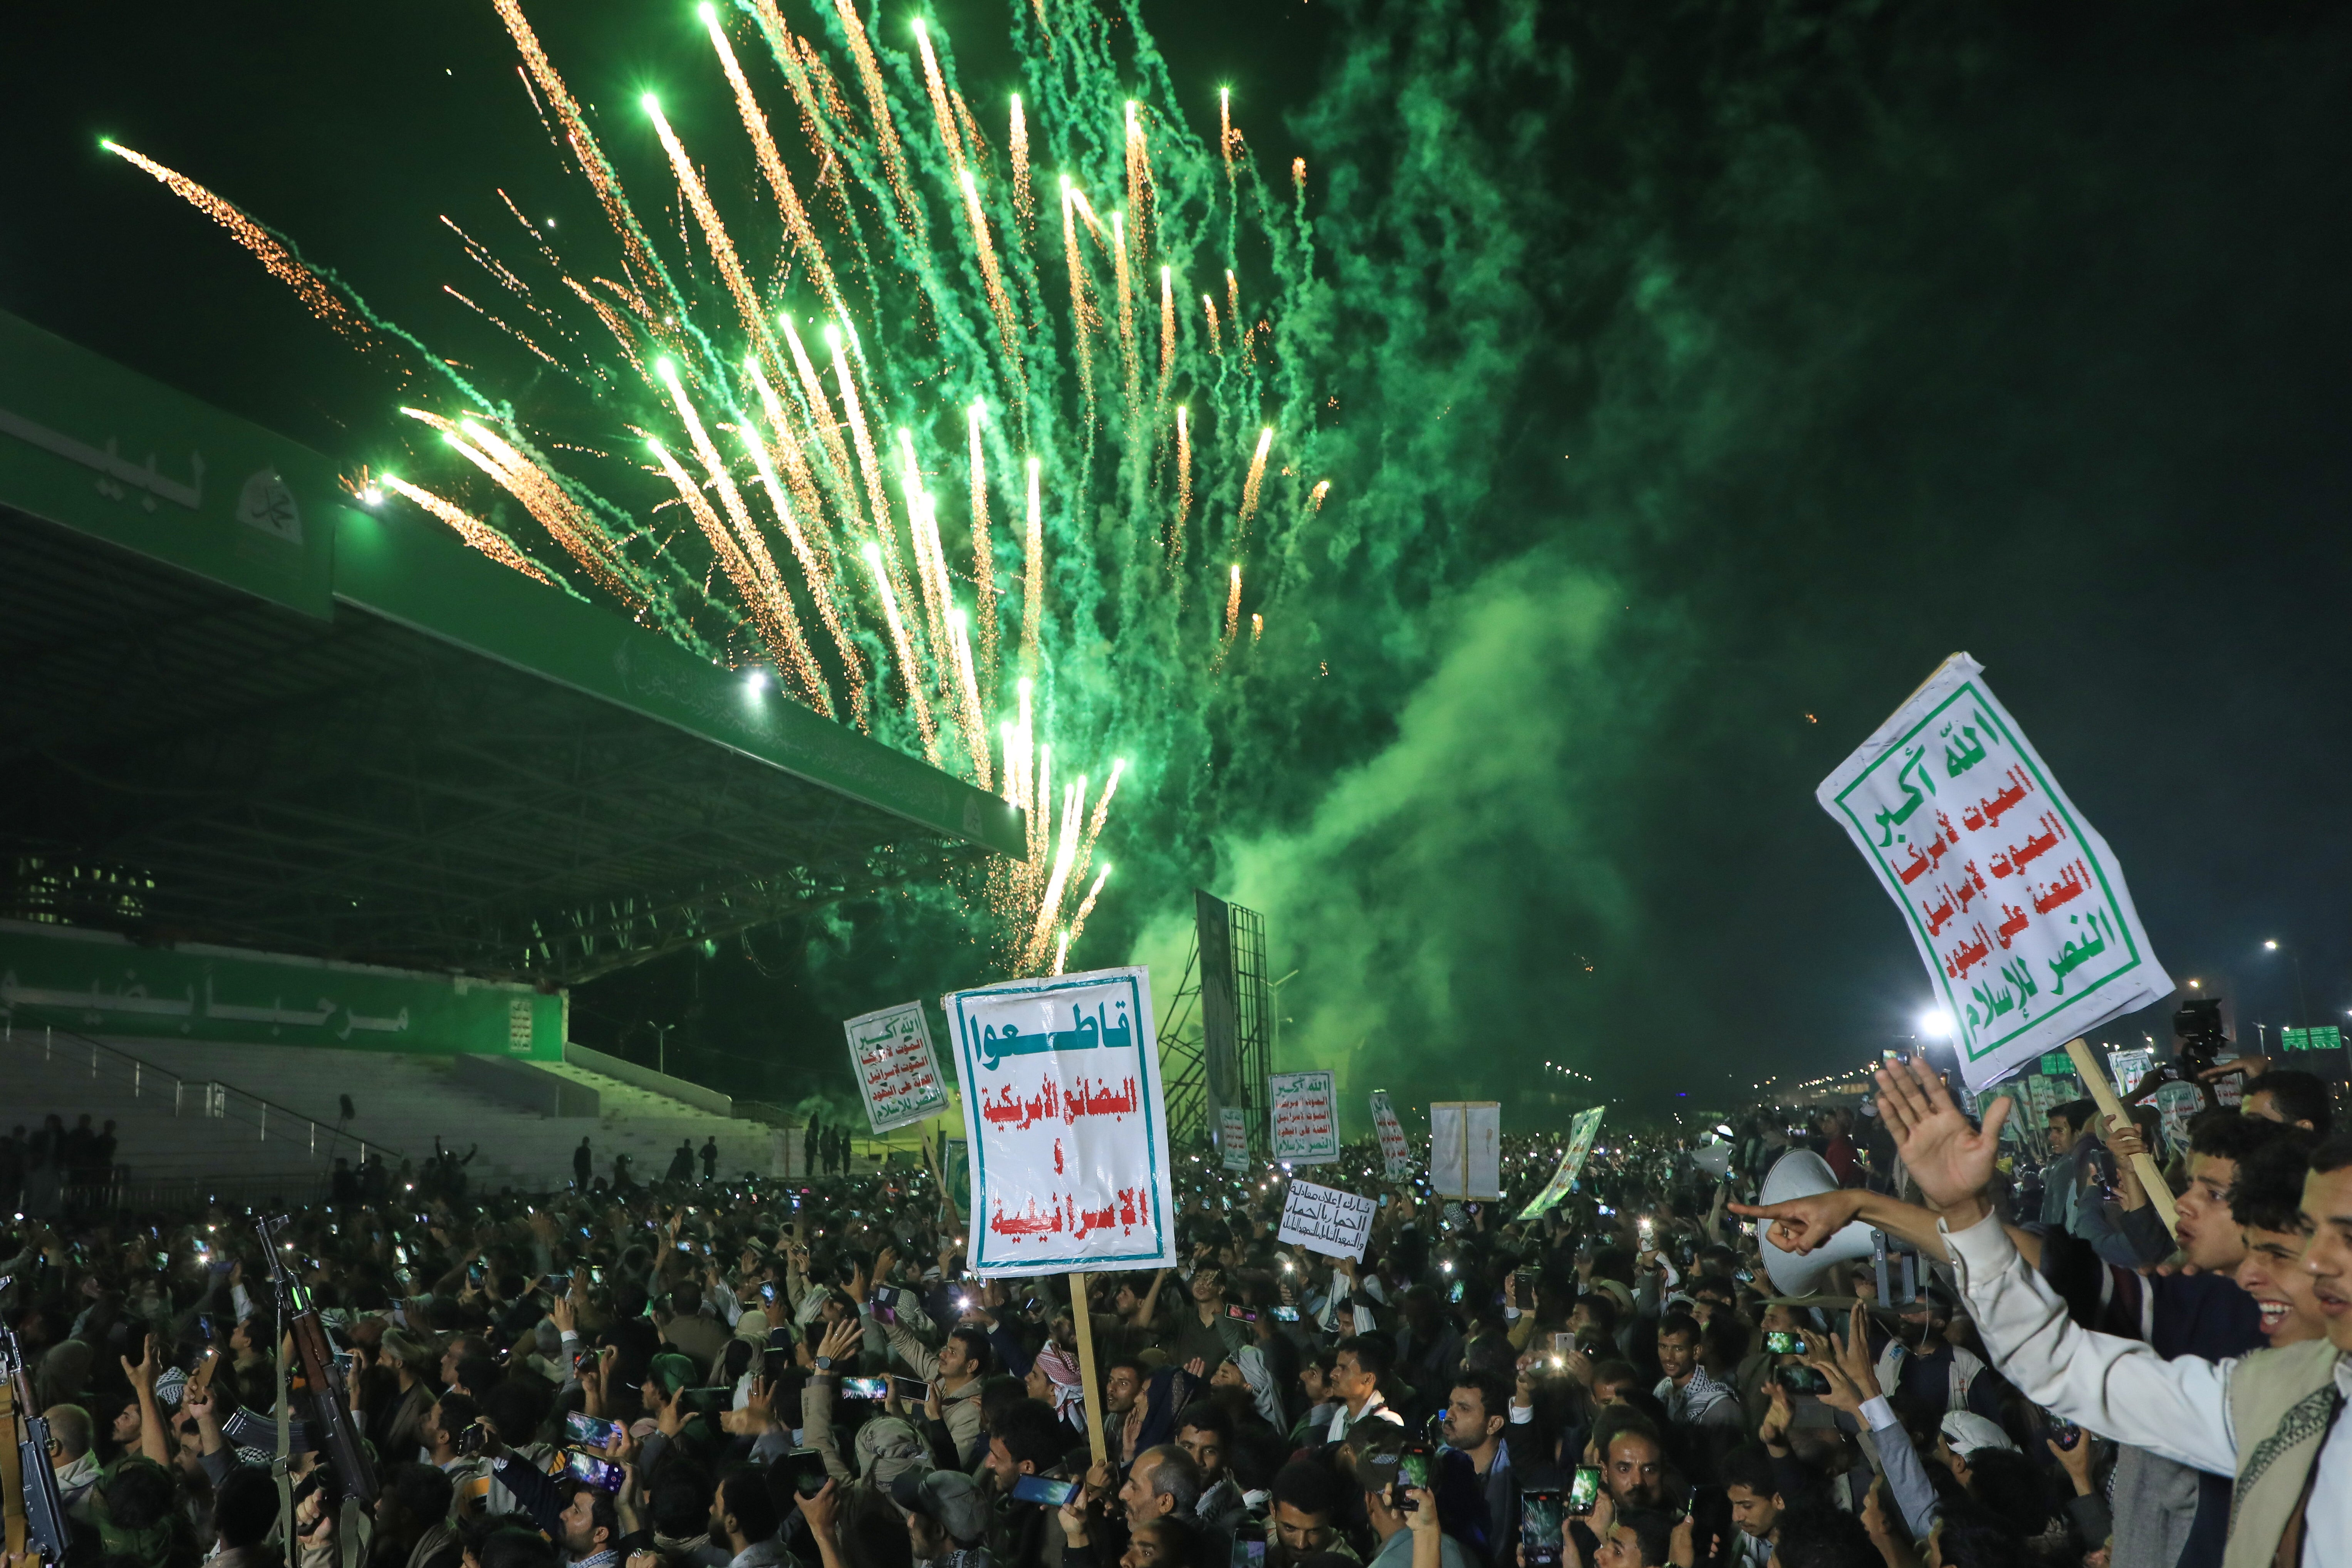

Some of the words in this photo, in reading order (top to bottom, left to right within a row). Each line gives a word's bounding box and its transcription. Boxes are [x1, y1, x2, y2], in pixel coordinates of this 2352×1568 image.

[1875, 744, 1936, 847] أكبر
[1963, 763, 2035, 832] الموت
[1891, 809, 1960, 885] لأمريكا
[1989, 809, 2067, 879] الموت
[1923, 859, 1987, 937] لإسرائيل
[2027, 857, 2093, 914] اللعنة
[1995, 903, 2030, 949] على
[2048, 905, 2116, 995] النصر
[1944, 921, 1995, 980] اليهود
[1966, 955, 2038, 1044] للإسلام
[858, 1017, 900, 1051] أكبر
[895, 1038, 924, 1055] الموت
[970, 1001, 1132, 1071] قاطعوا
[867, 1063, 900, 1085] لإسرائيل
[898, 1081, 912, 1095] على
[901, 1056, 929, 1073] الموت
[1276, 1077, 1305, 1098] أكبر
[872, 1085, 897, 1102] اليهود
[876, 1097, 912, 1122] للإسلام
[981, 1072, 1059, 1133] الأمريكية
[1063, 1075, 1137, 1126] البضائع
[1054, 1137, 1064, 1175] و
[1309, 1137, 1332, 1153] النصر
[990, 1186, 1149, 1244] الإسرائيلية
[1290, 1183, 1318, 1201] معادلة
[1318, 1191, 1343, 1209] إعلان
